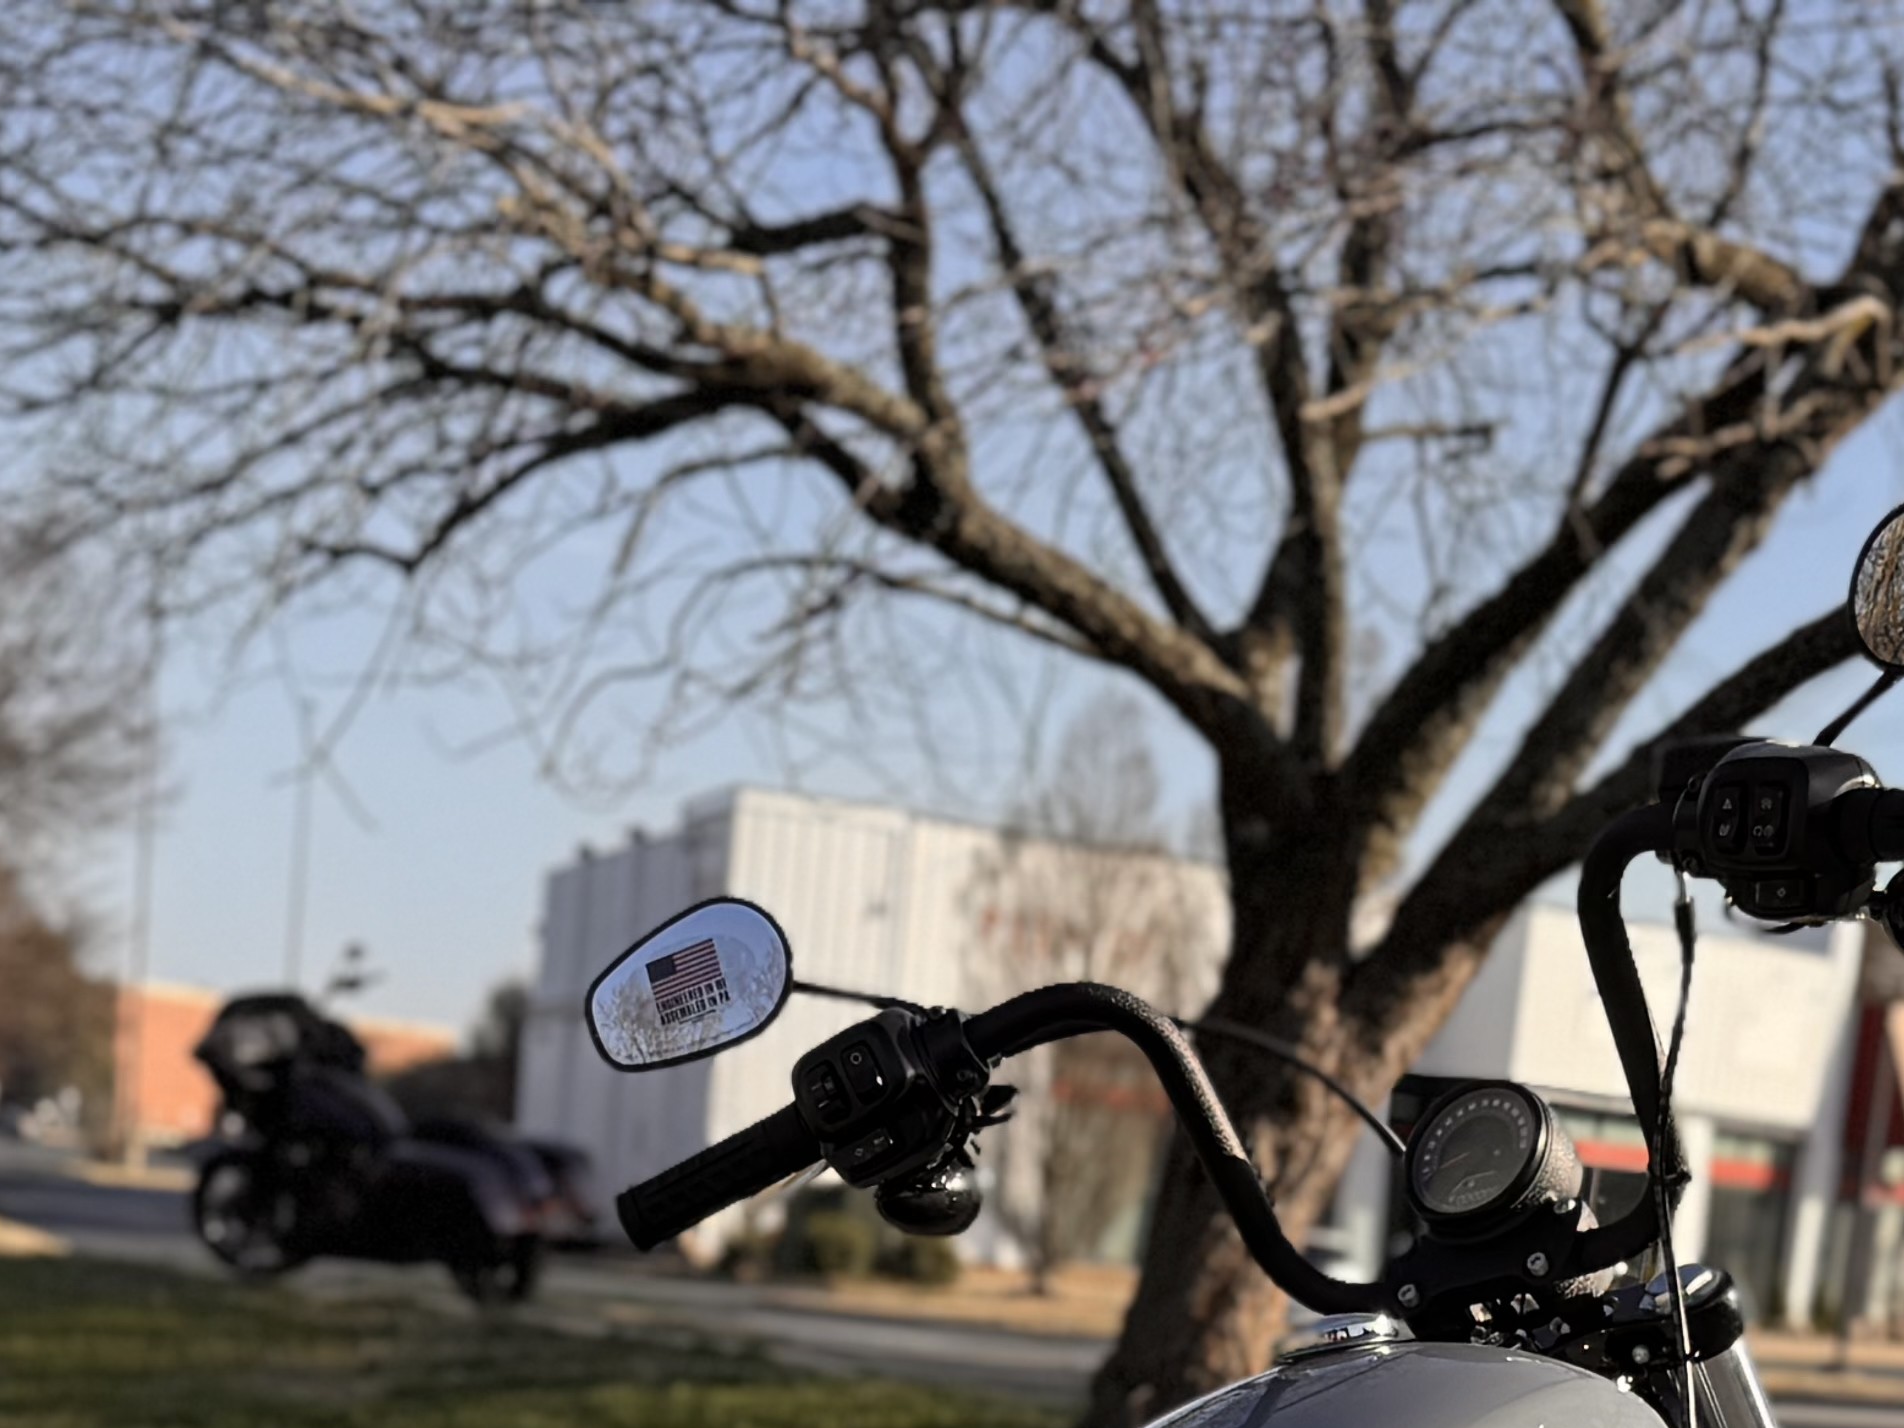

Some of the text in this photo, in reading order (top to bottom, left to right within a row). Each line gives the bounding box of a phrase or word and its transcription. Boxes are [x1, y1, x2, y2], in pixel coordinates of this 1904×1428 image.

[656, 985, 704, 1014] ENGINEERED
[704, 982, 714, 996] IN
[660, 998, 706, 1026] ASSEMBLED
[707, 995, 717, 1008] IN
[718, 989, 730, 1004] PA
